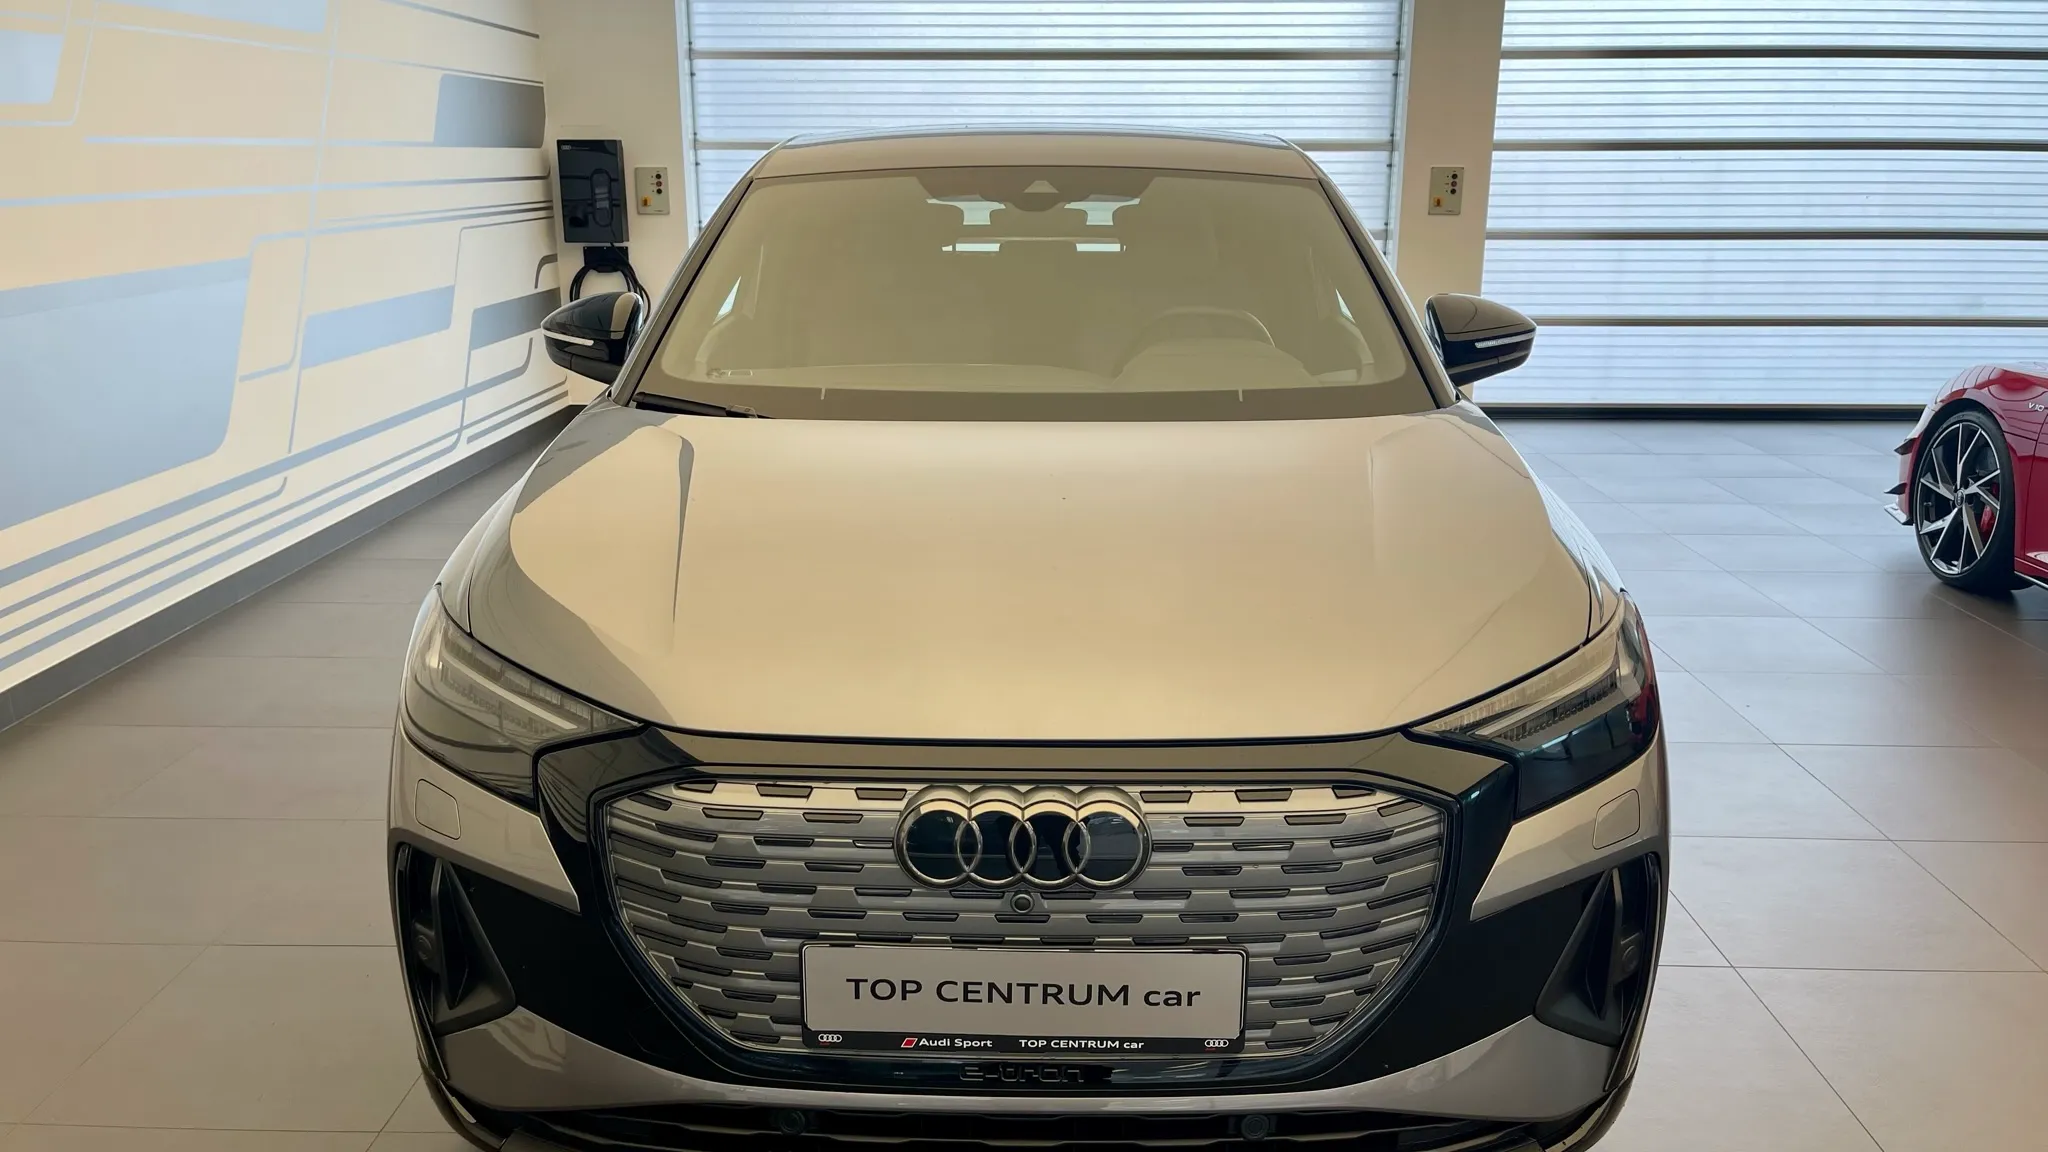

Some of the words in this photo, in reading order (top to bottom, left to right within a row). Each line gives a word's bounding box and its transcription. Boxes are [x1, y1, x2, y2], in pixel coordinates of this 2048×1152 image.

[846, 978, 922, 1002] TOP
[936, 980, 1130, 1007] CENTRUM
[1144, 989, 1201, 1008] car
[919, 1038, 950, 1047] Audi
[954, 1038, 993, 1049] Sport
[1019, 1039, 1047, 1048] TOP
[1050, 1040, 1120, 1049] CENTRUM
[1123, 1041, 1145, 1049] car
